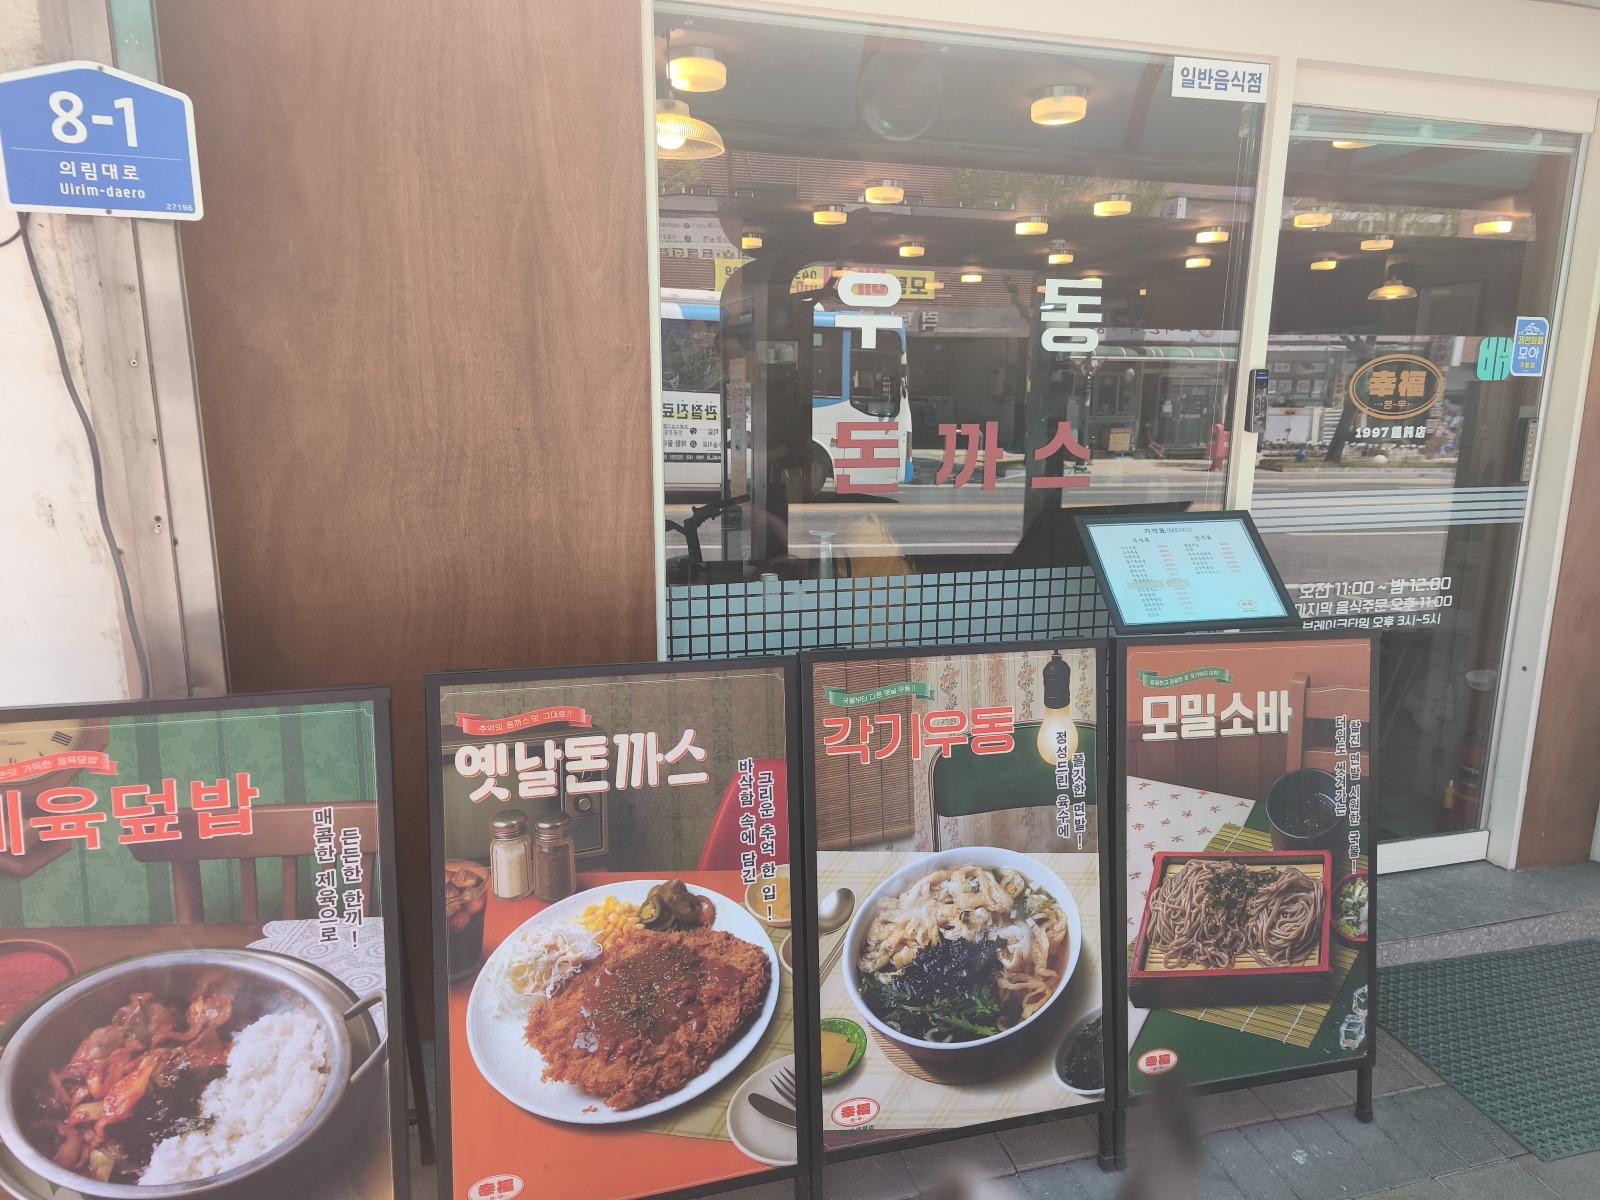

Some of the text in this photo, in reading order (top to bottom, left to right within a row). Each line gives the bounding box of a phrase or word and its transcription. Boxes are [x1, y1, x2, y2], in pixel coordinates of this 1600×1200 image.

[1180, 67, 1263, 94] 일반음식점
[48, 90, 139, 148] 8-1
[59, 160, 140, 181] 의림대로
[59, 182, 146, 200] Uirim-daero
[165, 202, 194, 213] 27196
[1519, 346, 1540, 359] 모아
[1368, 370, 1427, 397] 幸福
[1355, 427, 1390, 439] 1997
[834, 421, 1091, 494] 돈까스
[1299, 582, 1331, 599] 오전
[1336, 597, 1388, 615] 음식주문
[1373, 615, 1395, 629] 오후
[1142, 690, 1293, 742] 모밀소바
[822, 706, 1016, 765] 각기우동
[454, 727, 711, 804] 옛날돈까스
[758, 771, 775, 818] 그리운
[1348, 784, 1361, 827] 시원한
[738, 757, 757, 884] 바삭함 속에 담긴
[1056, 794, 1071, 838] 육수에
[339, 826, 363, 884] 든든한
[759, 824, 776, 856] 추억
[313, 806, 339, 943] 매콤한 제육으로
[761, 862, 776, 878] 한
